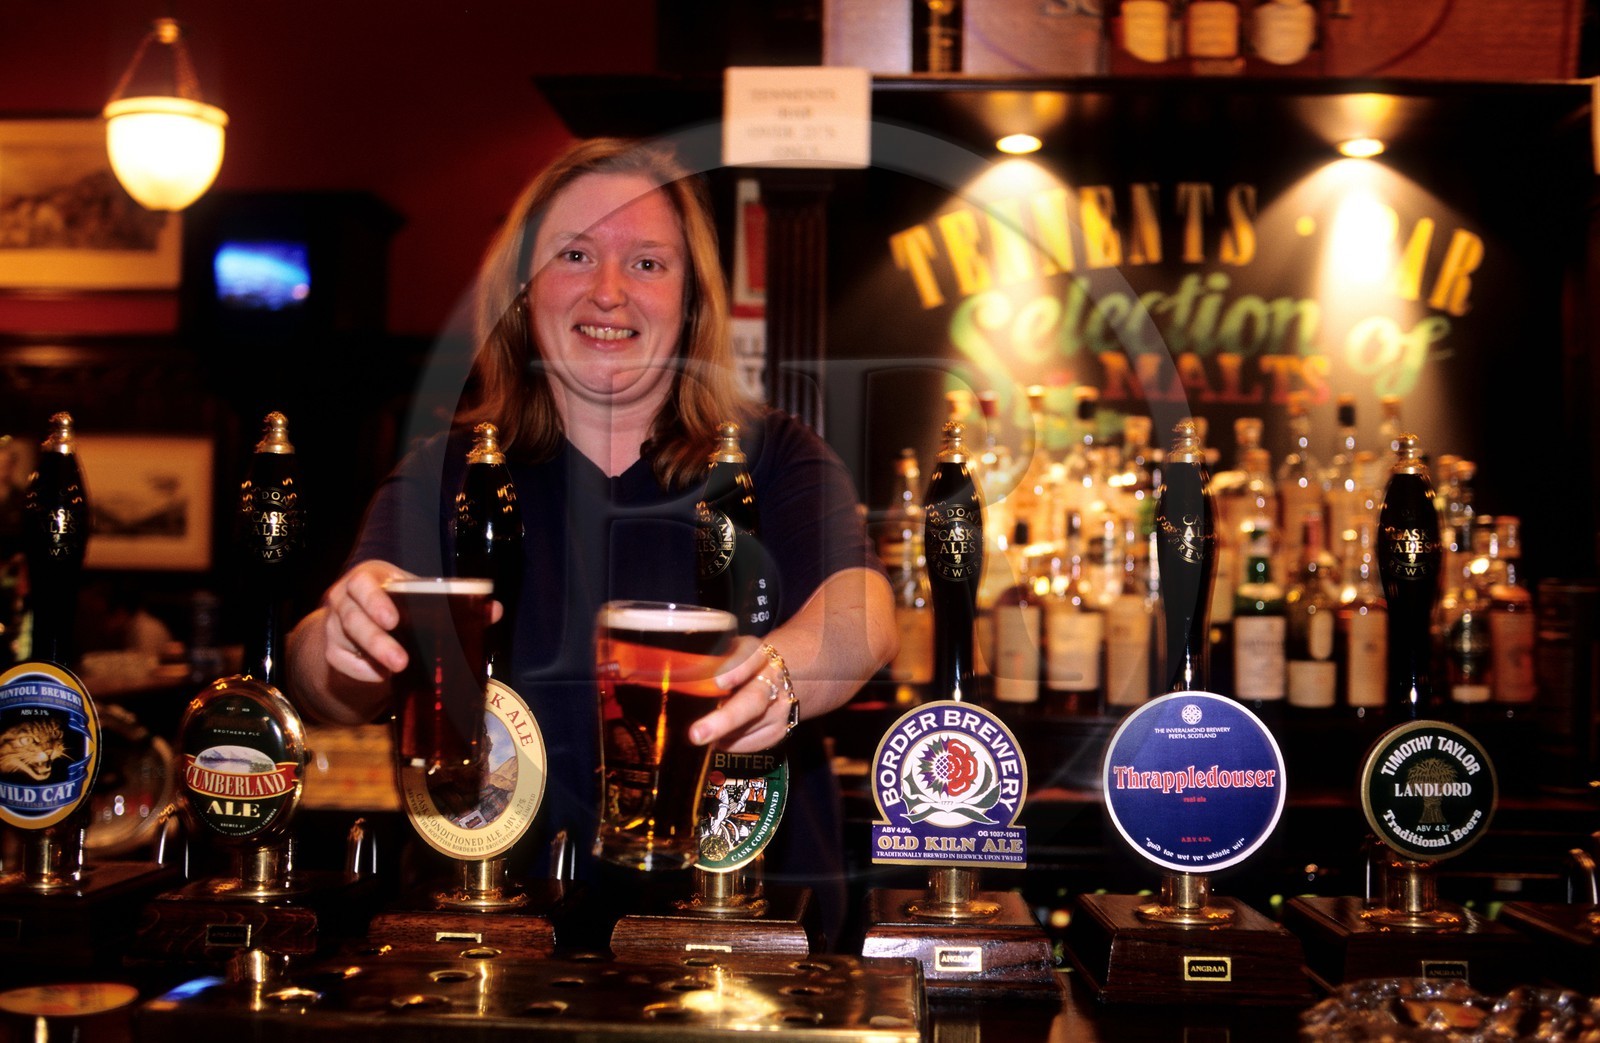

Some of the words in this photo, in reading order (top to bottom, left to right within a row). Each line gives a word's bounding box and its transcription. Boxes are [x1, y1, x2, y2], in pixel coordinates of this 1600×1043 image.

[948, 272, 1322, 415] Selection
[1346, 315, 1455, 399] of
[1099, 352, 1331, 405] MALTS
[938, 528, 975, 541] CASK
[940, 541, 976, 554] ALES
[41, 686, 82, 706] BREWERY
[506, 710, 534, 747] ALE
[714, 753, 776, 770] BITTER
[880, 713, 938, 807] BORDER
[943, 709, 1020, 813] BREWERY
[1380, 735, 1433, 776] TIMOTHY
[1437, 736, 1481, 776] TAYLOR
[186, 765, 286, 796] CUMBERLAND
[1113, 765, 1276, 794] Thrappledouser
[1394, 782, 1472, 797] LANDLORD
[42, 782, 76, 802] CAT
[206, 800, 261, 818] ALE
[730, 844, 752, 862] CASK
[751, 790, 780, 848] CONDITIONED
[1383, 809, 1451, 847] Traditional
[1450, 809, 1482, 842] Beers
[1416, 824, 1432, 832] ABV
[877, 835, 919, 850] OLD
[924, 836, 977, 852] KILN
[981, 838, 1023, 854] ALE
[1177, 853, 1190, 861] wet
[1206, 848, 1231, 860] whistle
[876, 851, 922, 859] TRADITIONALLY
[1190, 965, 1226, 973] ANGRAM
